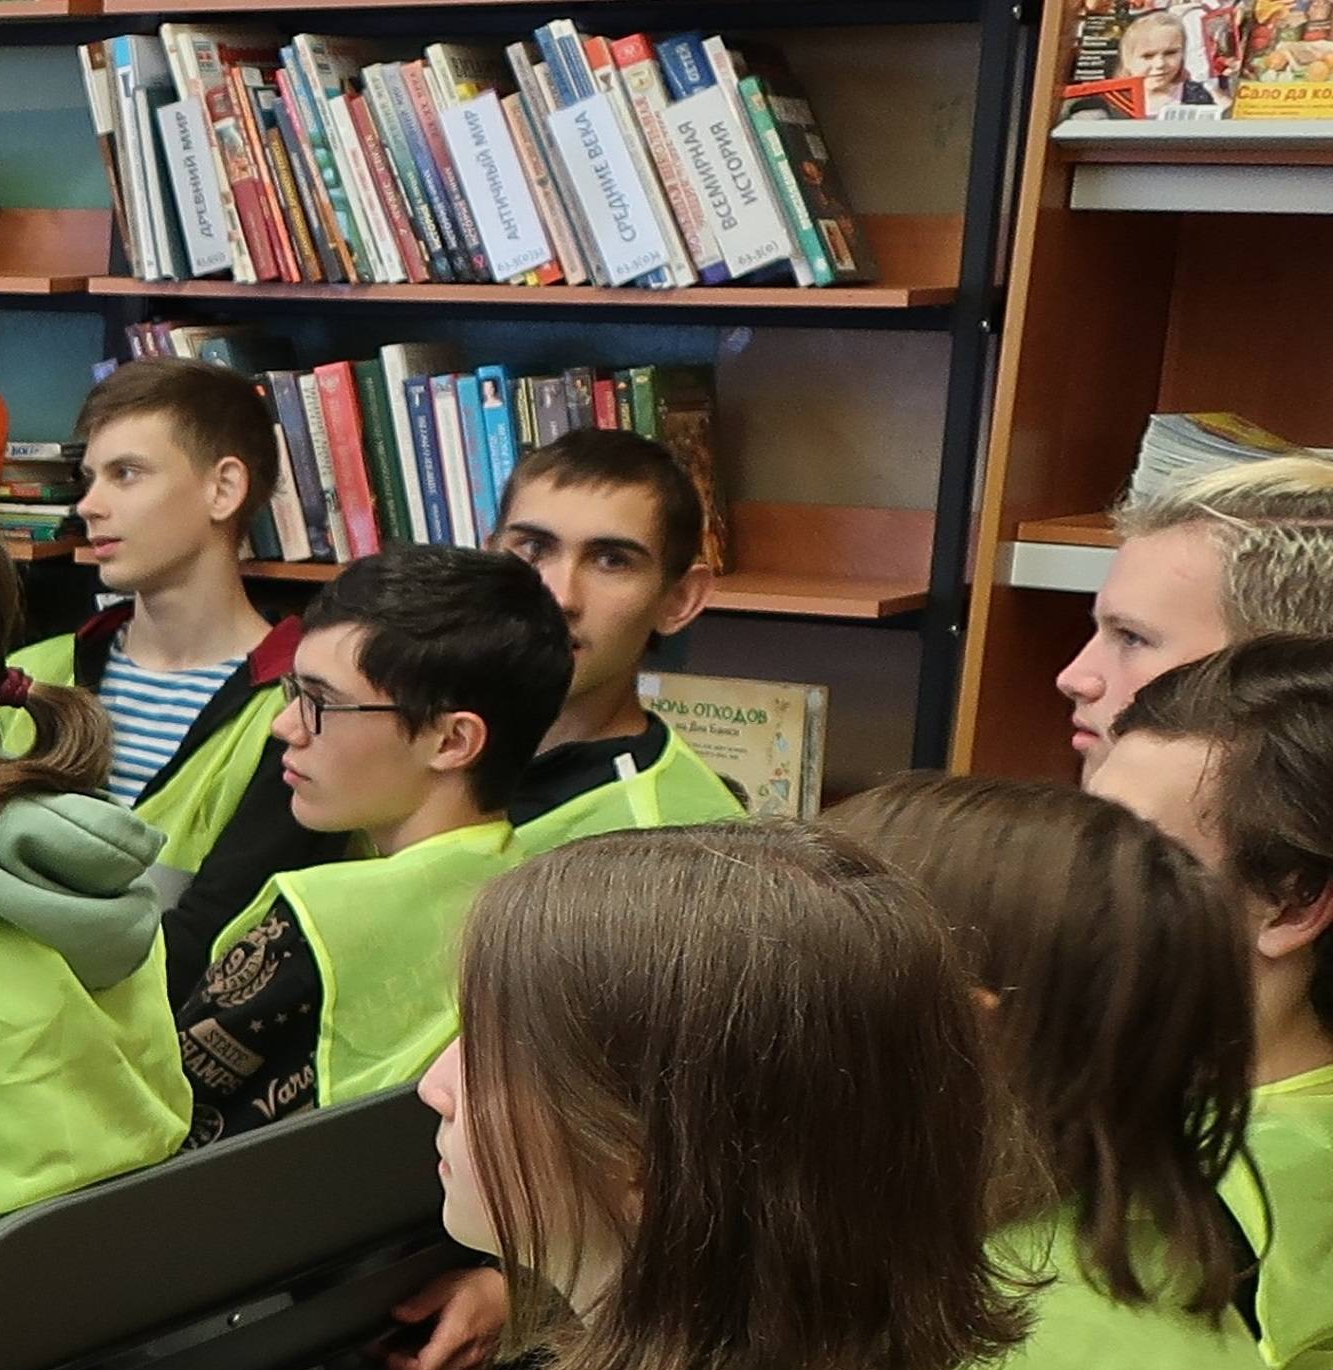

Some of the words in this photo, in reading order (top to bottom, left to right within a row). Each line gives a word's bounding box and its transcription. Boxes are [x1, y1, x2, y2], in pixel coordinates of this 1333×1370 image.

[1312, 88, 1333, 99] ко
[176, 110, 194, 153] МИР
[464, 109, 486, 148] МИР
[574, 110, 603, 158] ВЕКА
[475, 147, 521, 241] АНТИЧНЫЙ
[676, 119, 739, 231] ВСЕМИРНАЯ
[710, 120, 760, 205] ИСТОРИЯ
[189, 153, 214, 239] ДРЕВНИЙ
[593, 159, 636, 243] СРЕДНИЕ
[693, 702, 769, 726] ОТХОДОВ
